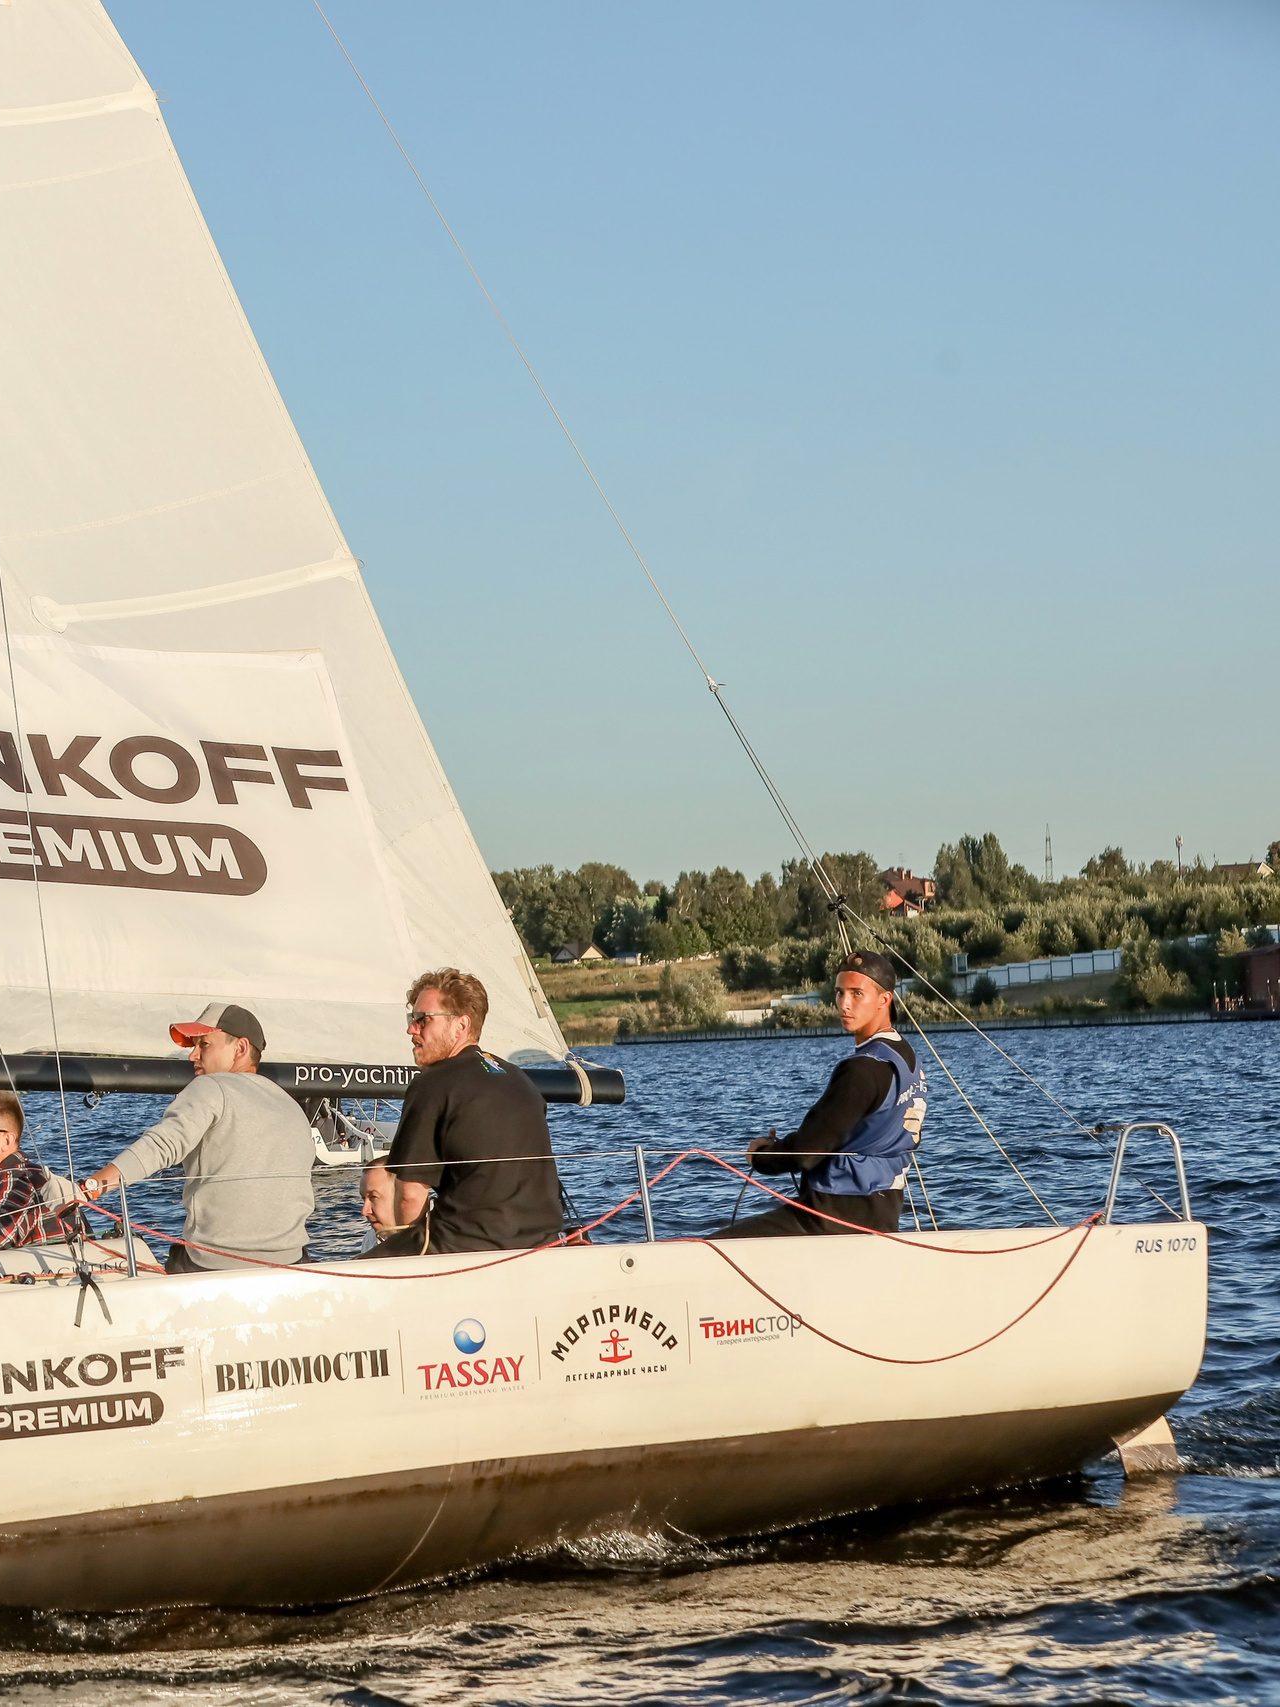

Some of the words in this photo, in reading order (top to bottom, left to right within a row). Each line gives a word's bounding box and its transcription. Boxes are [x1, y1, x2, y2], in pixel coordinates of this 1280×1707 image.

[1135, 1239, 1163, 1253] RUS
[1167, 1238, 1196, 1251] 1070
[551, 1305, 678, 1361] МОРПРИБОР
[215, 1348, 390, 1393] ВЕДОМОСТИ
[416, 1355, 525, 1391] TASSAY
[565, 1367, 636, 1382] ЛЕГЕНДАРНЫЕ
[640, 1364, 667, 1374] ЧАСЫ
[459, 1387, 497, 1397] DRINKING
[501, 1384, 525, 1392] WATER
